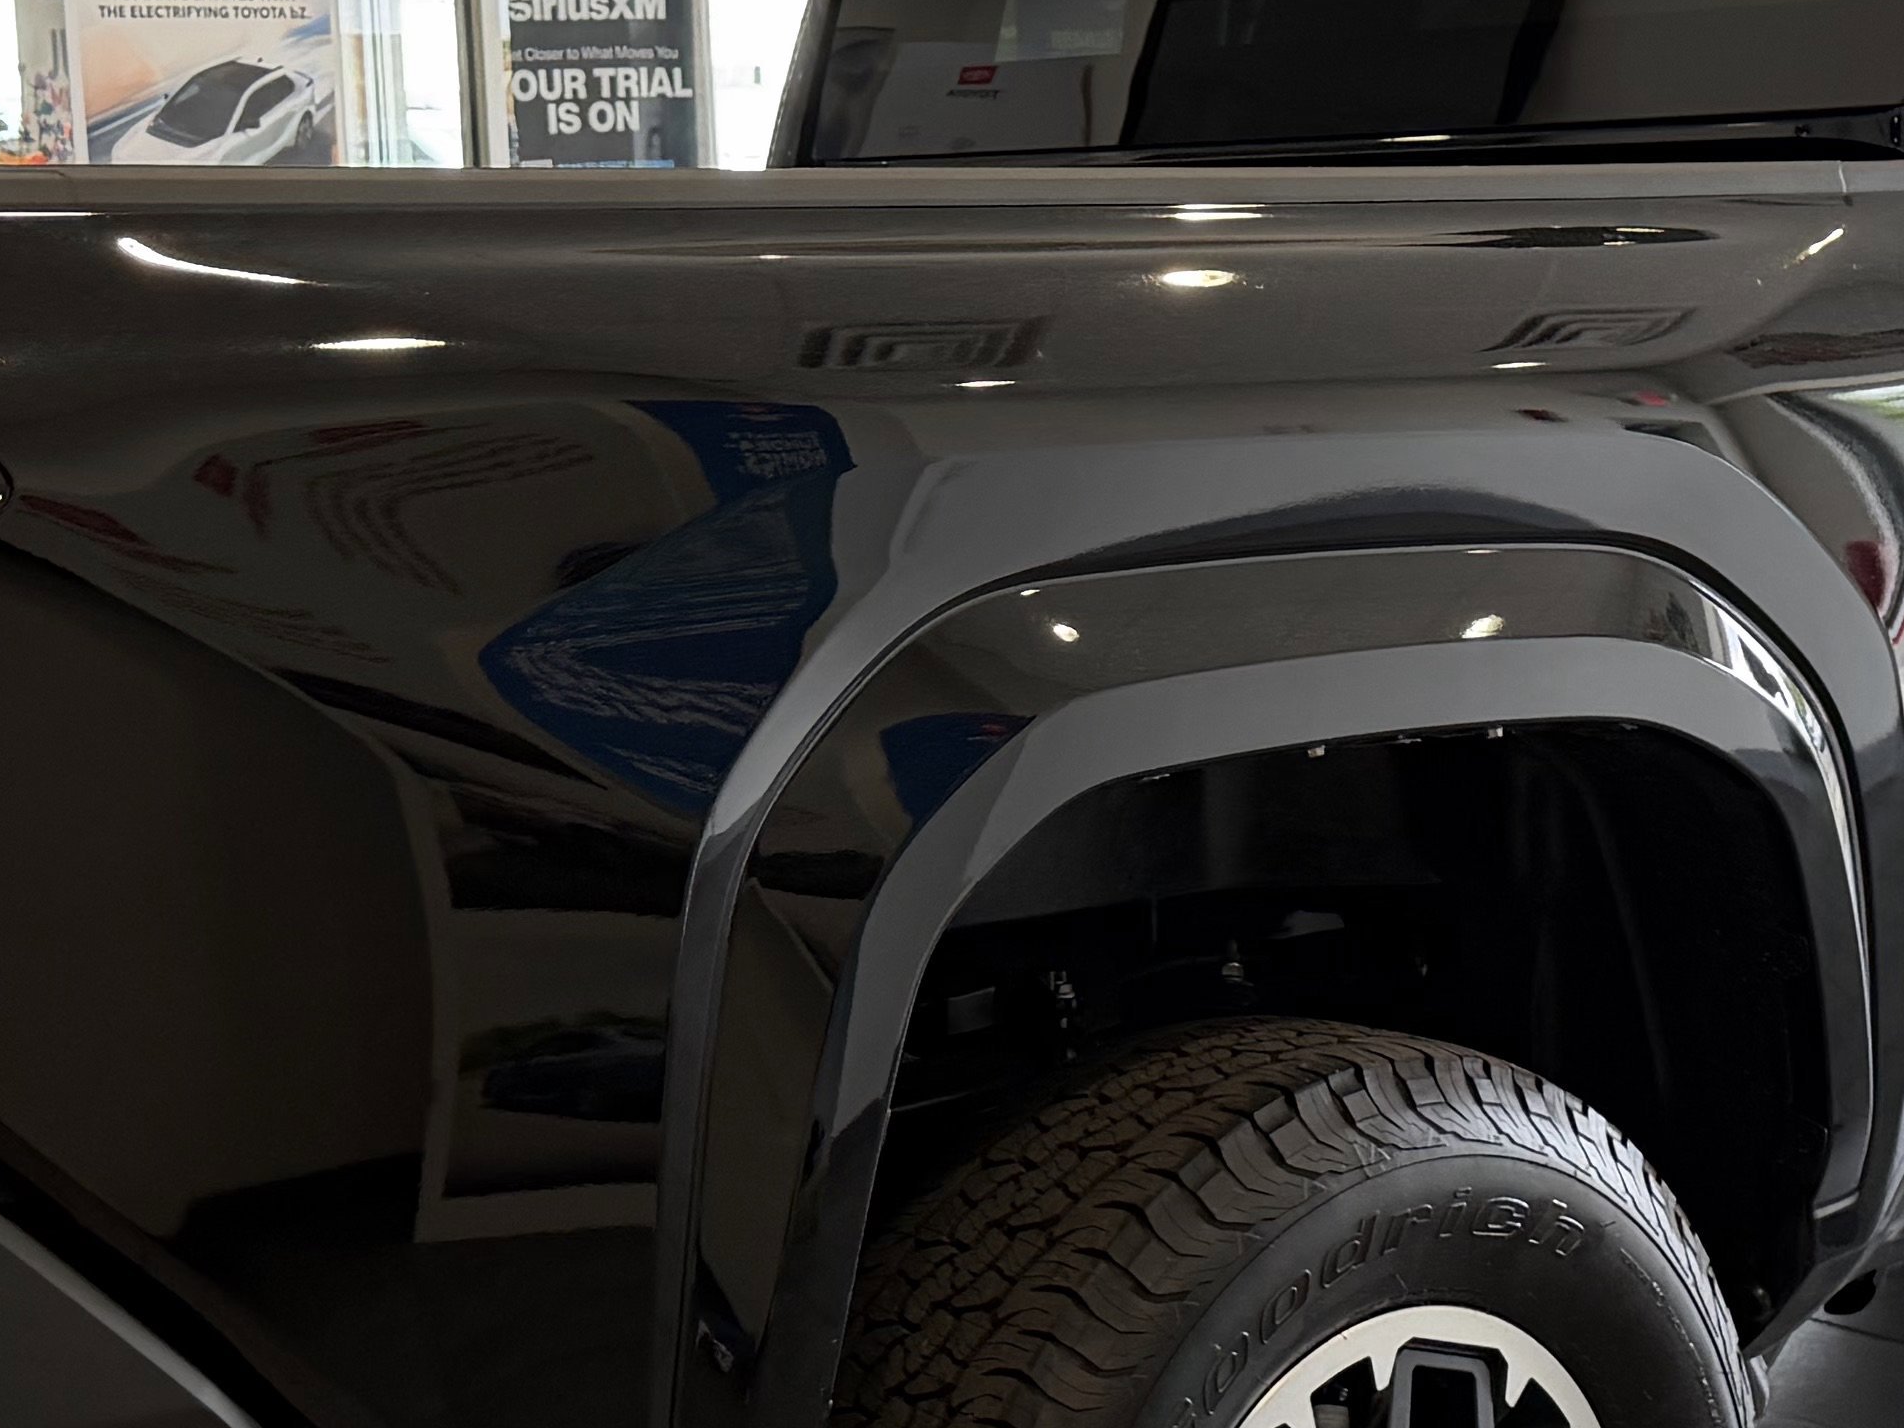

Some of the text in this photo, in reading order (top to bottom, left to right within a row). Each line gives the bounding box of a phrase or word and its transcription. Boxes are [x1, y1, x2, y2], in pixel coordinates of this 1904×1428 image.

[98, 5, 127, 19] THE
[130, 5, 230, 19] ELECTRIFYING
[232, 6, 287, 20] TOYOTA
[524, 46, 564, 62] Closer
[566, 47, 580, 61] to
[580, 45, 615, 60] What
[614, 45, 655, 60] Moves
[654, 45, 680, 60] You
[512, 66, 694, 102] OUR TRIAL
[546, 100, 641, 135] IS ON
